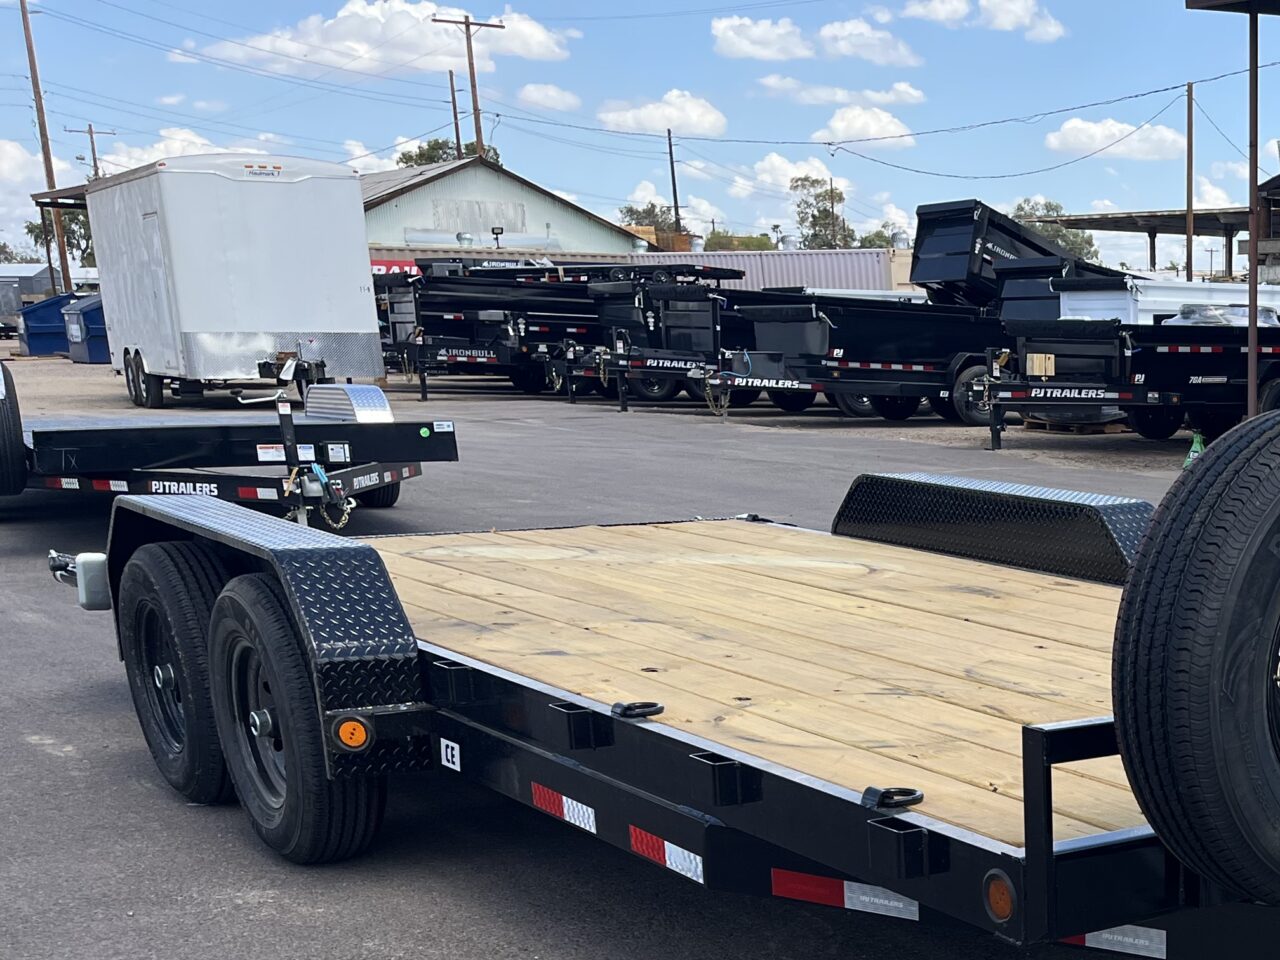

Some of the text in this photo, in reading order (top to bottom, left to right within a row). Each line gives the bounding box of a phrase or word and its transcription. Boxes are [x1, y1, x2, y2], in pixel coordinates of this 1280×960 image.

[448, 349, 496, 358] IRONBULL
[746, 378, 799, 389] TRAILERS
[1045, 388, 1106, 399] TRAILERS
[163, 481, 219, 496] TRAILERS
